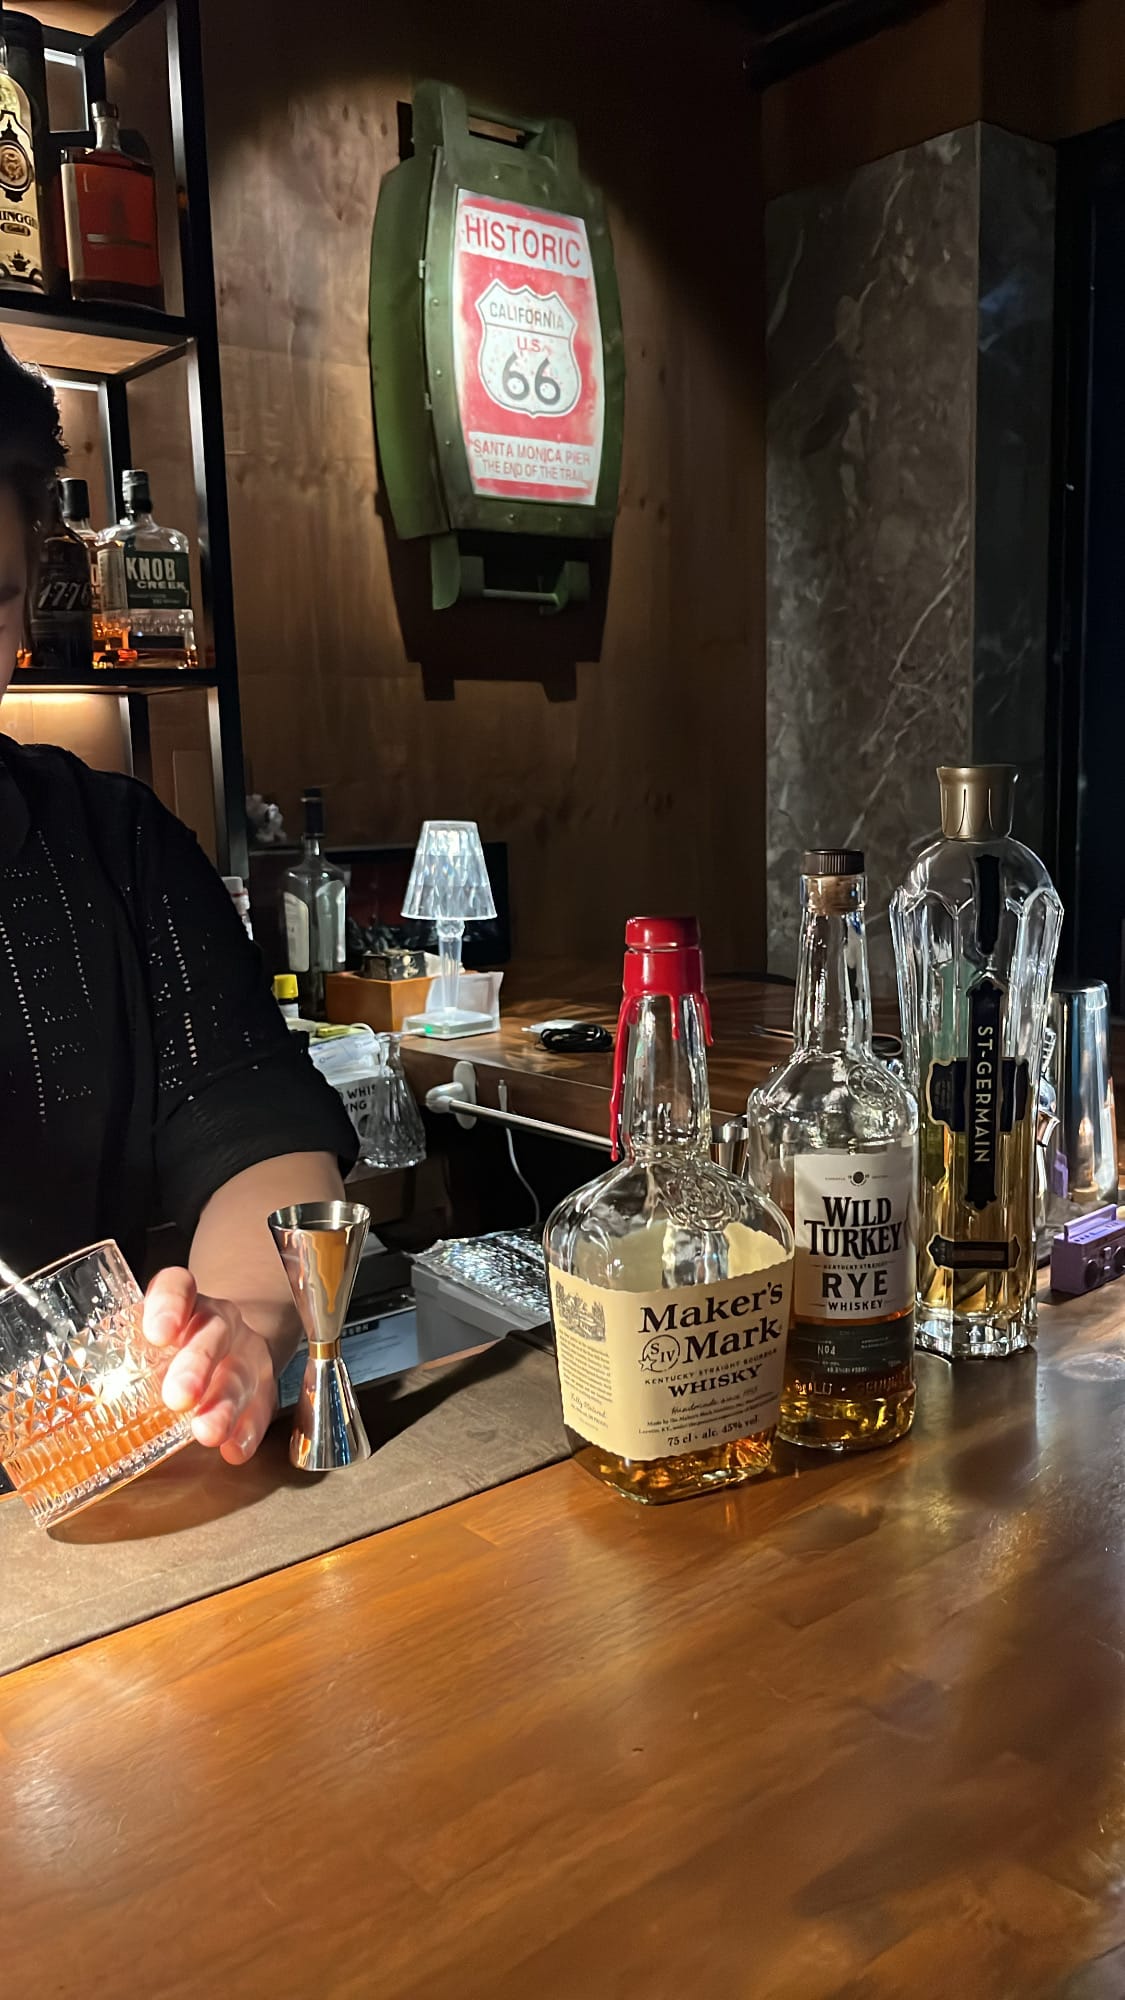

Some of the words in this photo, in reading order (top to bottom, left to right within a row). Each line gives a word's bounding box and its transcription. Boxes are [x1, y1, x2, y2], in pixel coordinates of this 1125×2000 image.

[465, 214, 581, 268] HISTORIC
[489, 302, 564, 330] CALIFORNIA
[502, 351, 561, 406] 66
[474, 439, 514, 458] SANTA
[517, 444, 562, 464] MONICA
[565, 450, 591, 465] PIER
[482, 459, 501, 473] THE
[504, 462, 523, 477] END
[524, 463, 537, 477] OF
[540, 465, 558, 480] THE
[126, 557, 176, 580] KNOB
[137, 580, 186, 591] CREEK
[821, 1196, 892, 1227] WILD
[803, 1219, 902, 1260] TURKEY
[822, 1270, 888, 1298] RYE
[638, 1281, 783, 1333] Maker's
[828, 1299, 884, 1311] WHISKEY
[682, 1316, 781, 1364] Mark
[645, 1372, 694, 1385] KENTUCKY
[699, 1362, 740, 1376] STRAIGHT
[668, 1363, 763, 1398] WHISKY
[668, 1436, 680, 1447] 75
[683, 1433, 692, 1444] cl
[721, 1420, 743, 1433] 45%
